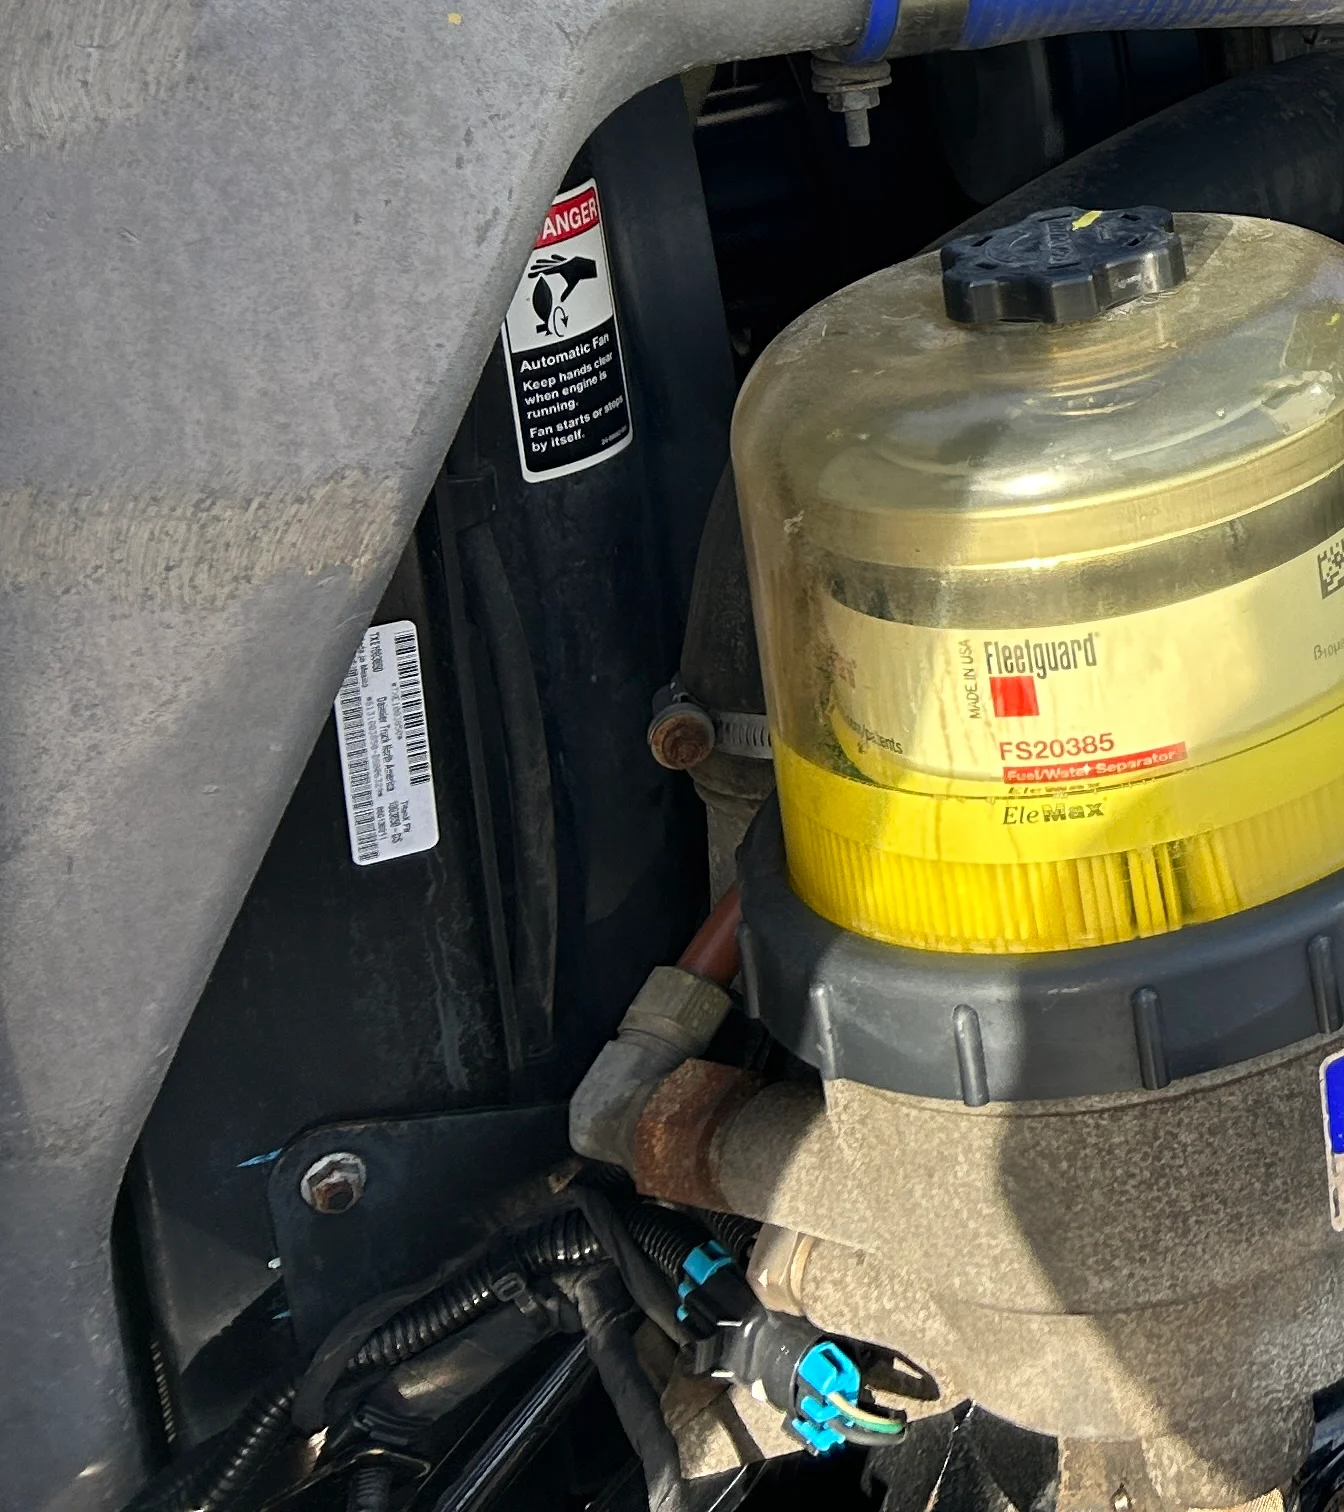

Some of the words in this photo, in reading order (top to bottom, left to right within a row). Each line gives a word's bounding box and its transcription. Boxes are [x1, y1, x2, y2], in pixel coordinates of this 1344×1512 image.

[540, 197, 598, 240] ANGER
[519, 341, 590, 373] Automatic
[592, 332, 610, 350] Fan
[522, 376, 556, 392] Keep
[558, 363, 593, 383] hands
[593, 351, 613, 371] clear
[524, 389, 560, 406] when
[561, 376, 598, 398] engine
[599, 371, 608, 382] is
[526, 400, 580, 420] running.
[529, 425, 554, 438] Fan
[556, 414, 591, 434] starts
[592, 408, 604, 419] or
[604, 394, 624, 415] stops
[531, 439, 548, 454] by
[550, 428, 586, 448] itself.
[958, 639, 974, 665] USA
[983, 632, 1098, 679] Fleetguard
[963, 668, 977, 680] IN
[964, 683, 982, 719] MADE
[999, 732, 1115, 761] FS20385
[1095, 750, 1177, 774] Separator
[1002, 802, 1104, 825] EleMax
